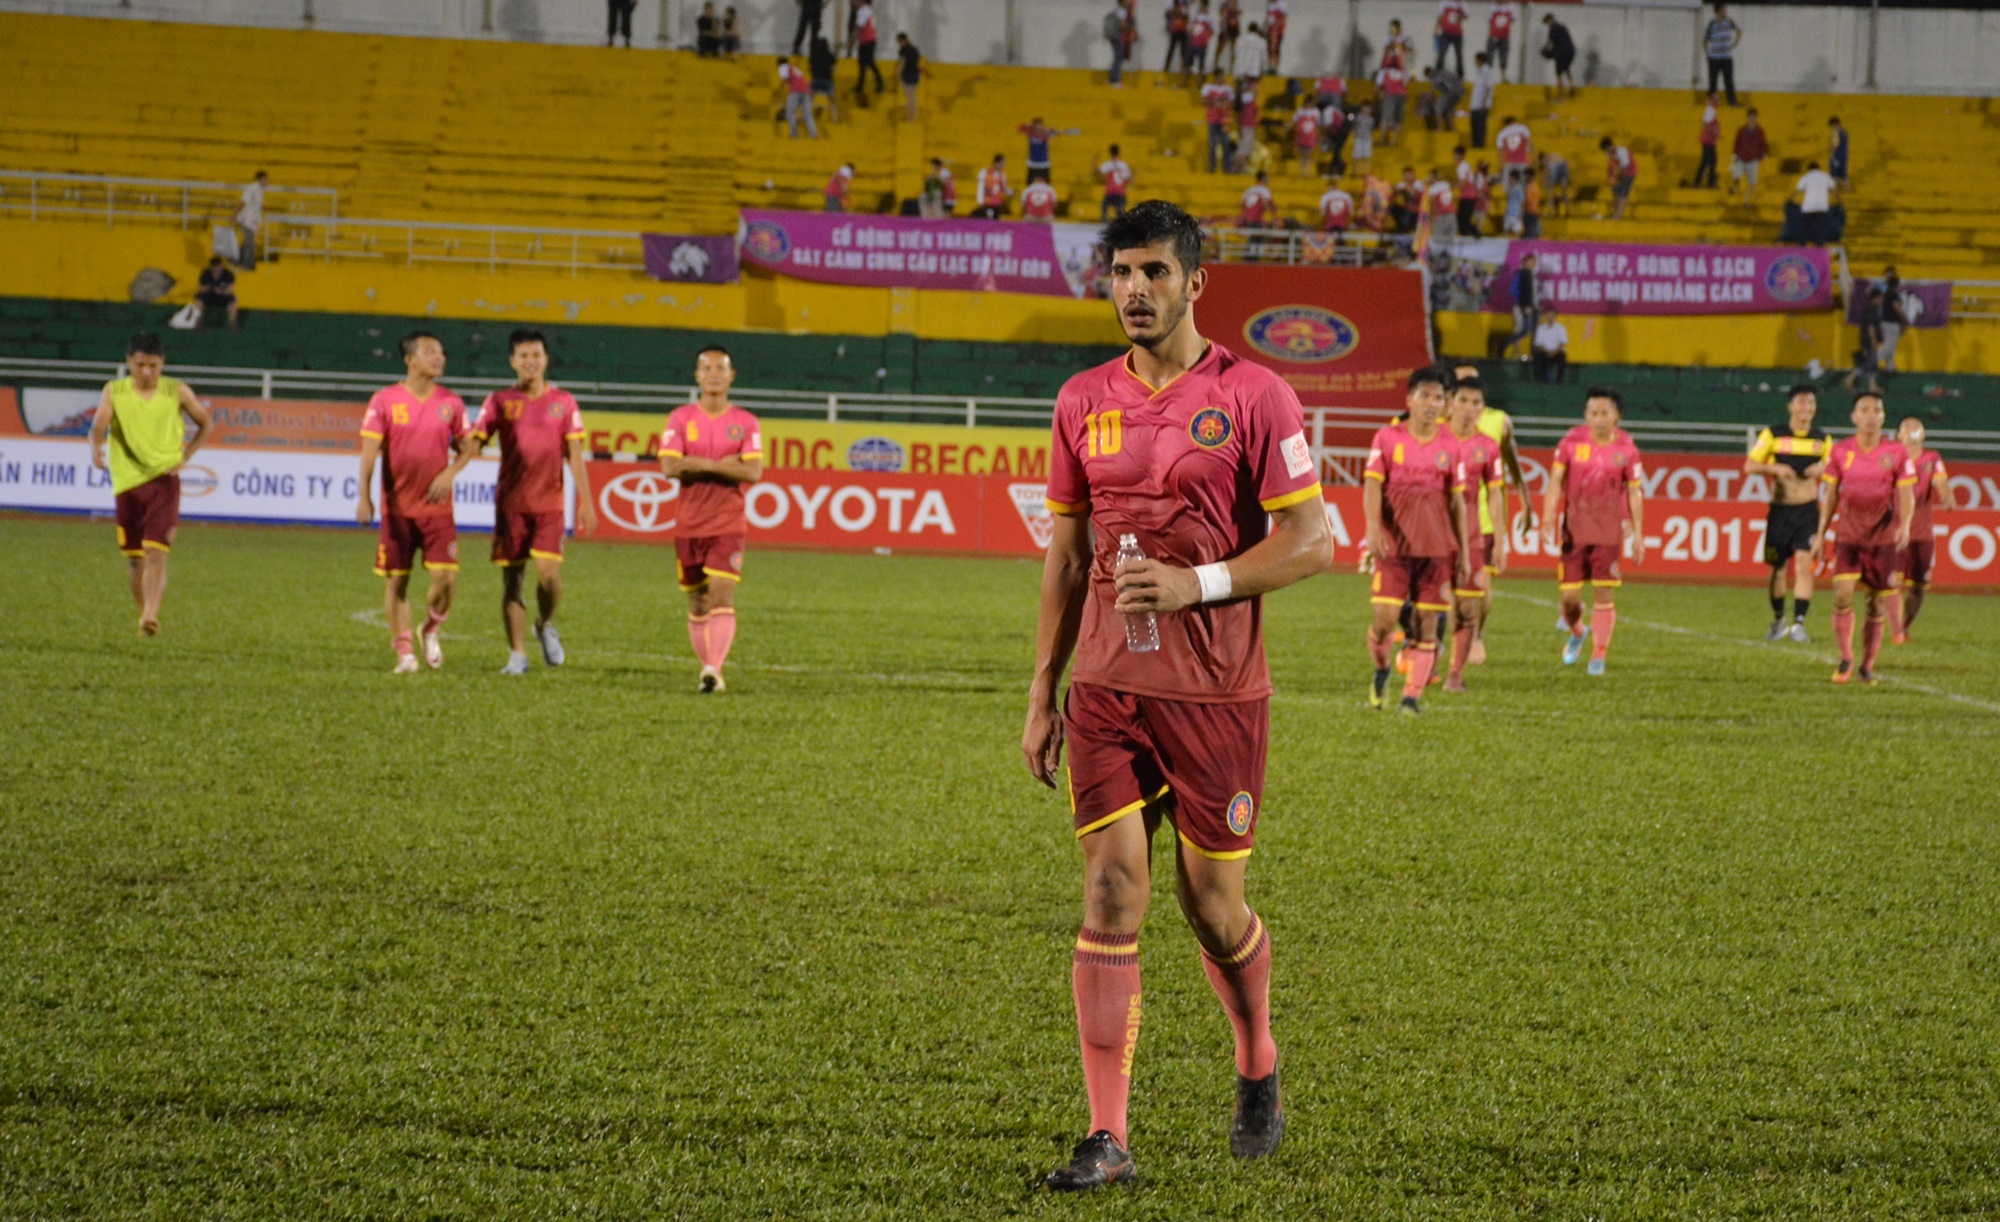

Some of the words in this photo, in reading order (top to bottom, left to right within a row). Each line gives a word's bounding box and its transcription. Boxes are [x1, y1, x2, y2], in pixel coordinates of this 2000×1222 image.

[1085, 410, 1122, 457] 10
[32, 463, 75, 485] HIM
[87, 465, 112, 488] LA
[911, 443, 1047, 477] BECAM
[233, 467, 294, 497] CÔNG
[307, 475, 332, 498] TY
[1641, 466, 1773, 502] YOTA
[745, 481, 956, 534] OYOTA
[1120, 993, 1142, 1077] SAIGON
